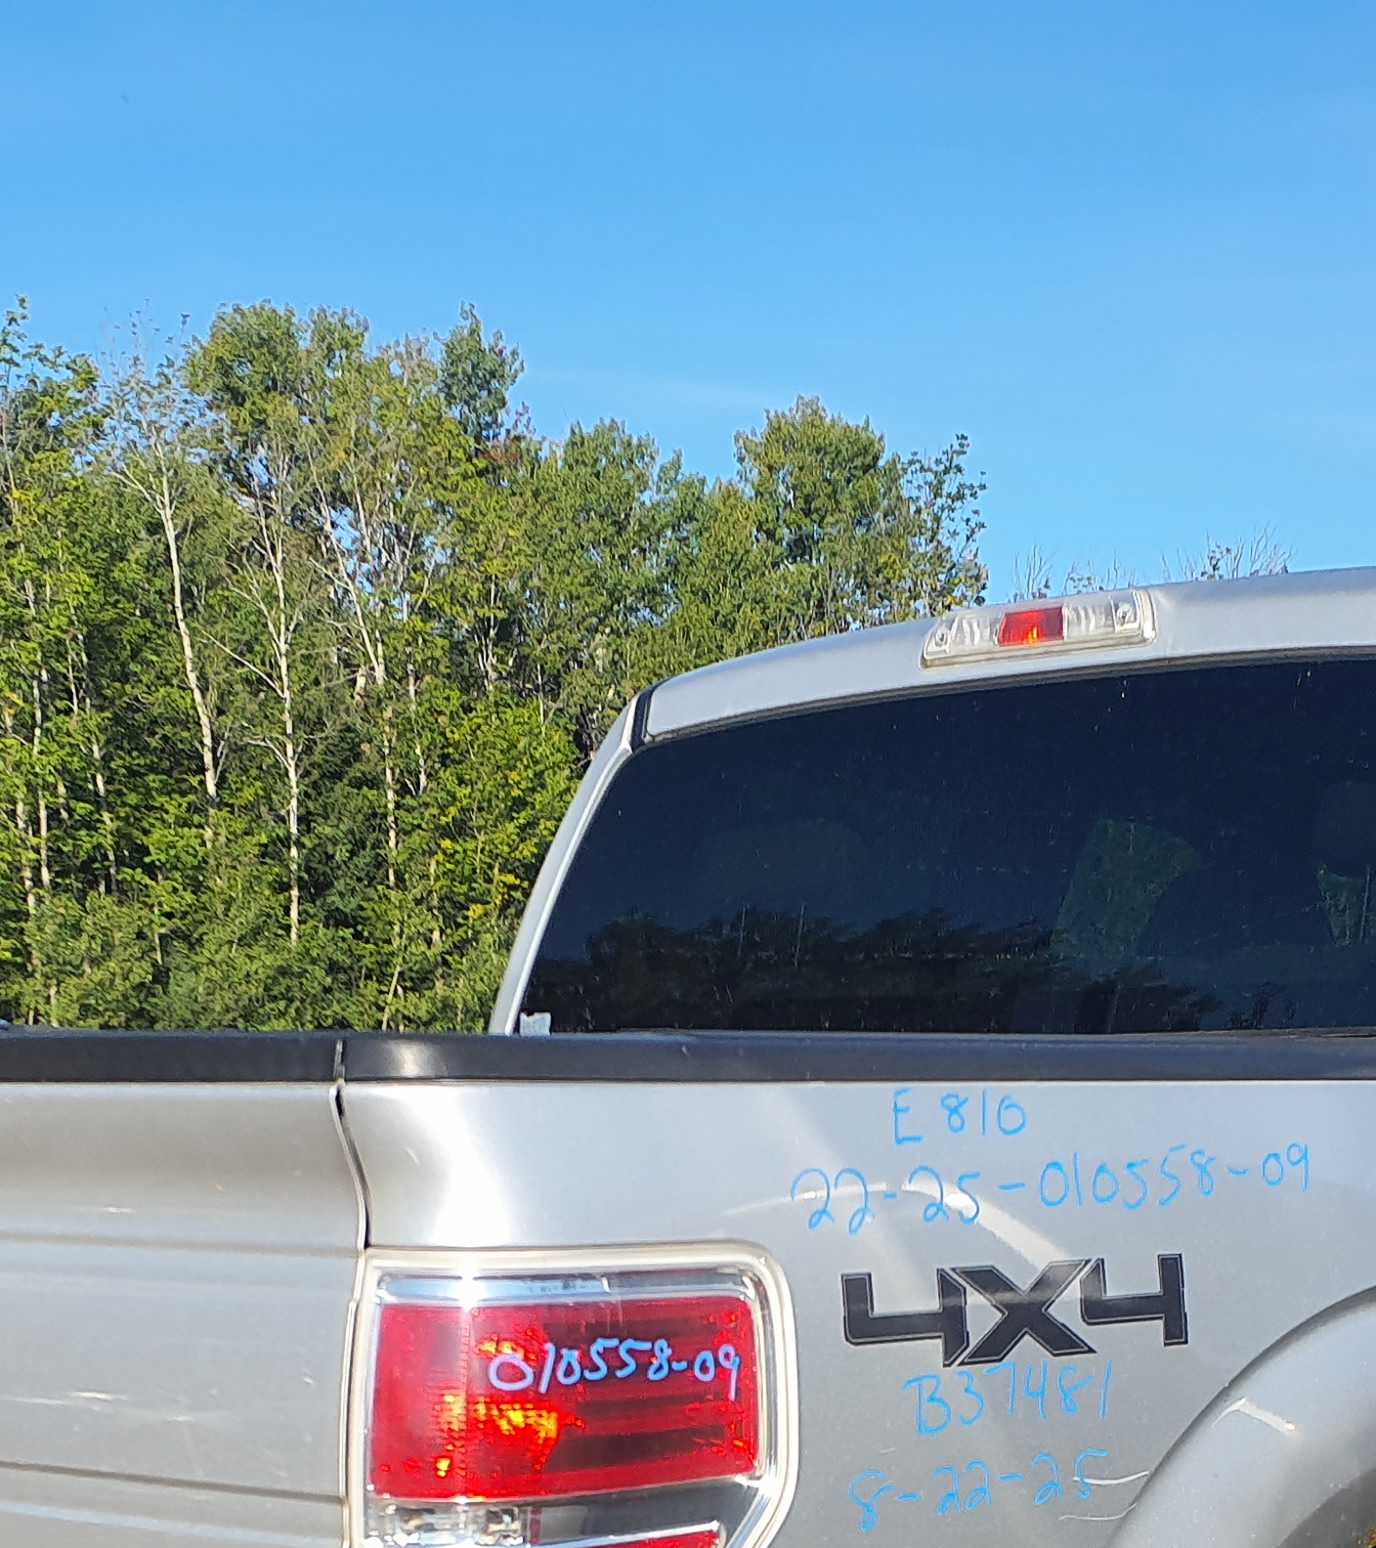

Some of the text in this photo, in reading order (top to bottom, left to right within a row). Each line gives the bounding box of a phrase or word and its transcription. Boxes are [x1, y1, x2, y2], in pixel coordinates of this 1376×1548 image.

[891, 1087, 1027, 1146] E 810
[789, 1141, 1313, 1236] 22-25-010558-09
[839, 1252, 1190, 1368] 4X4
[488, 1335, 743, 1402] 010558-09
